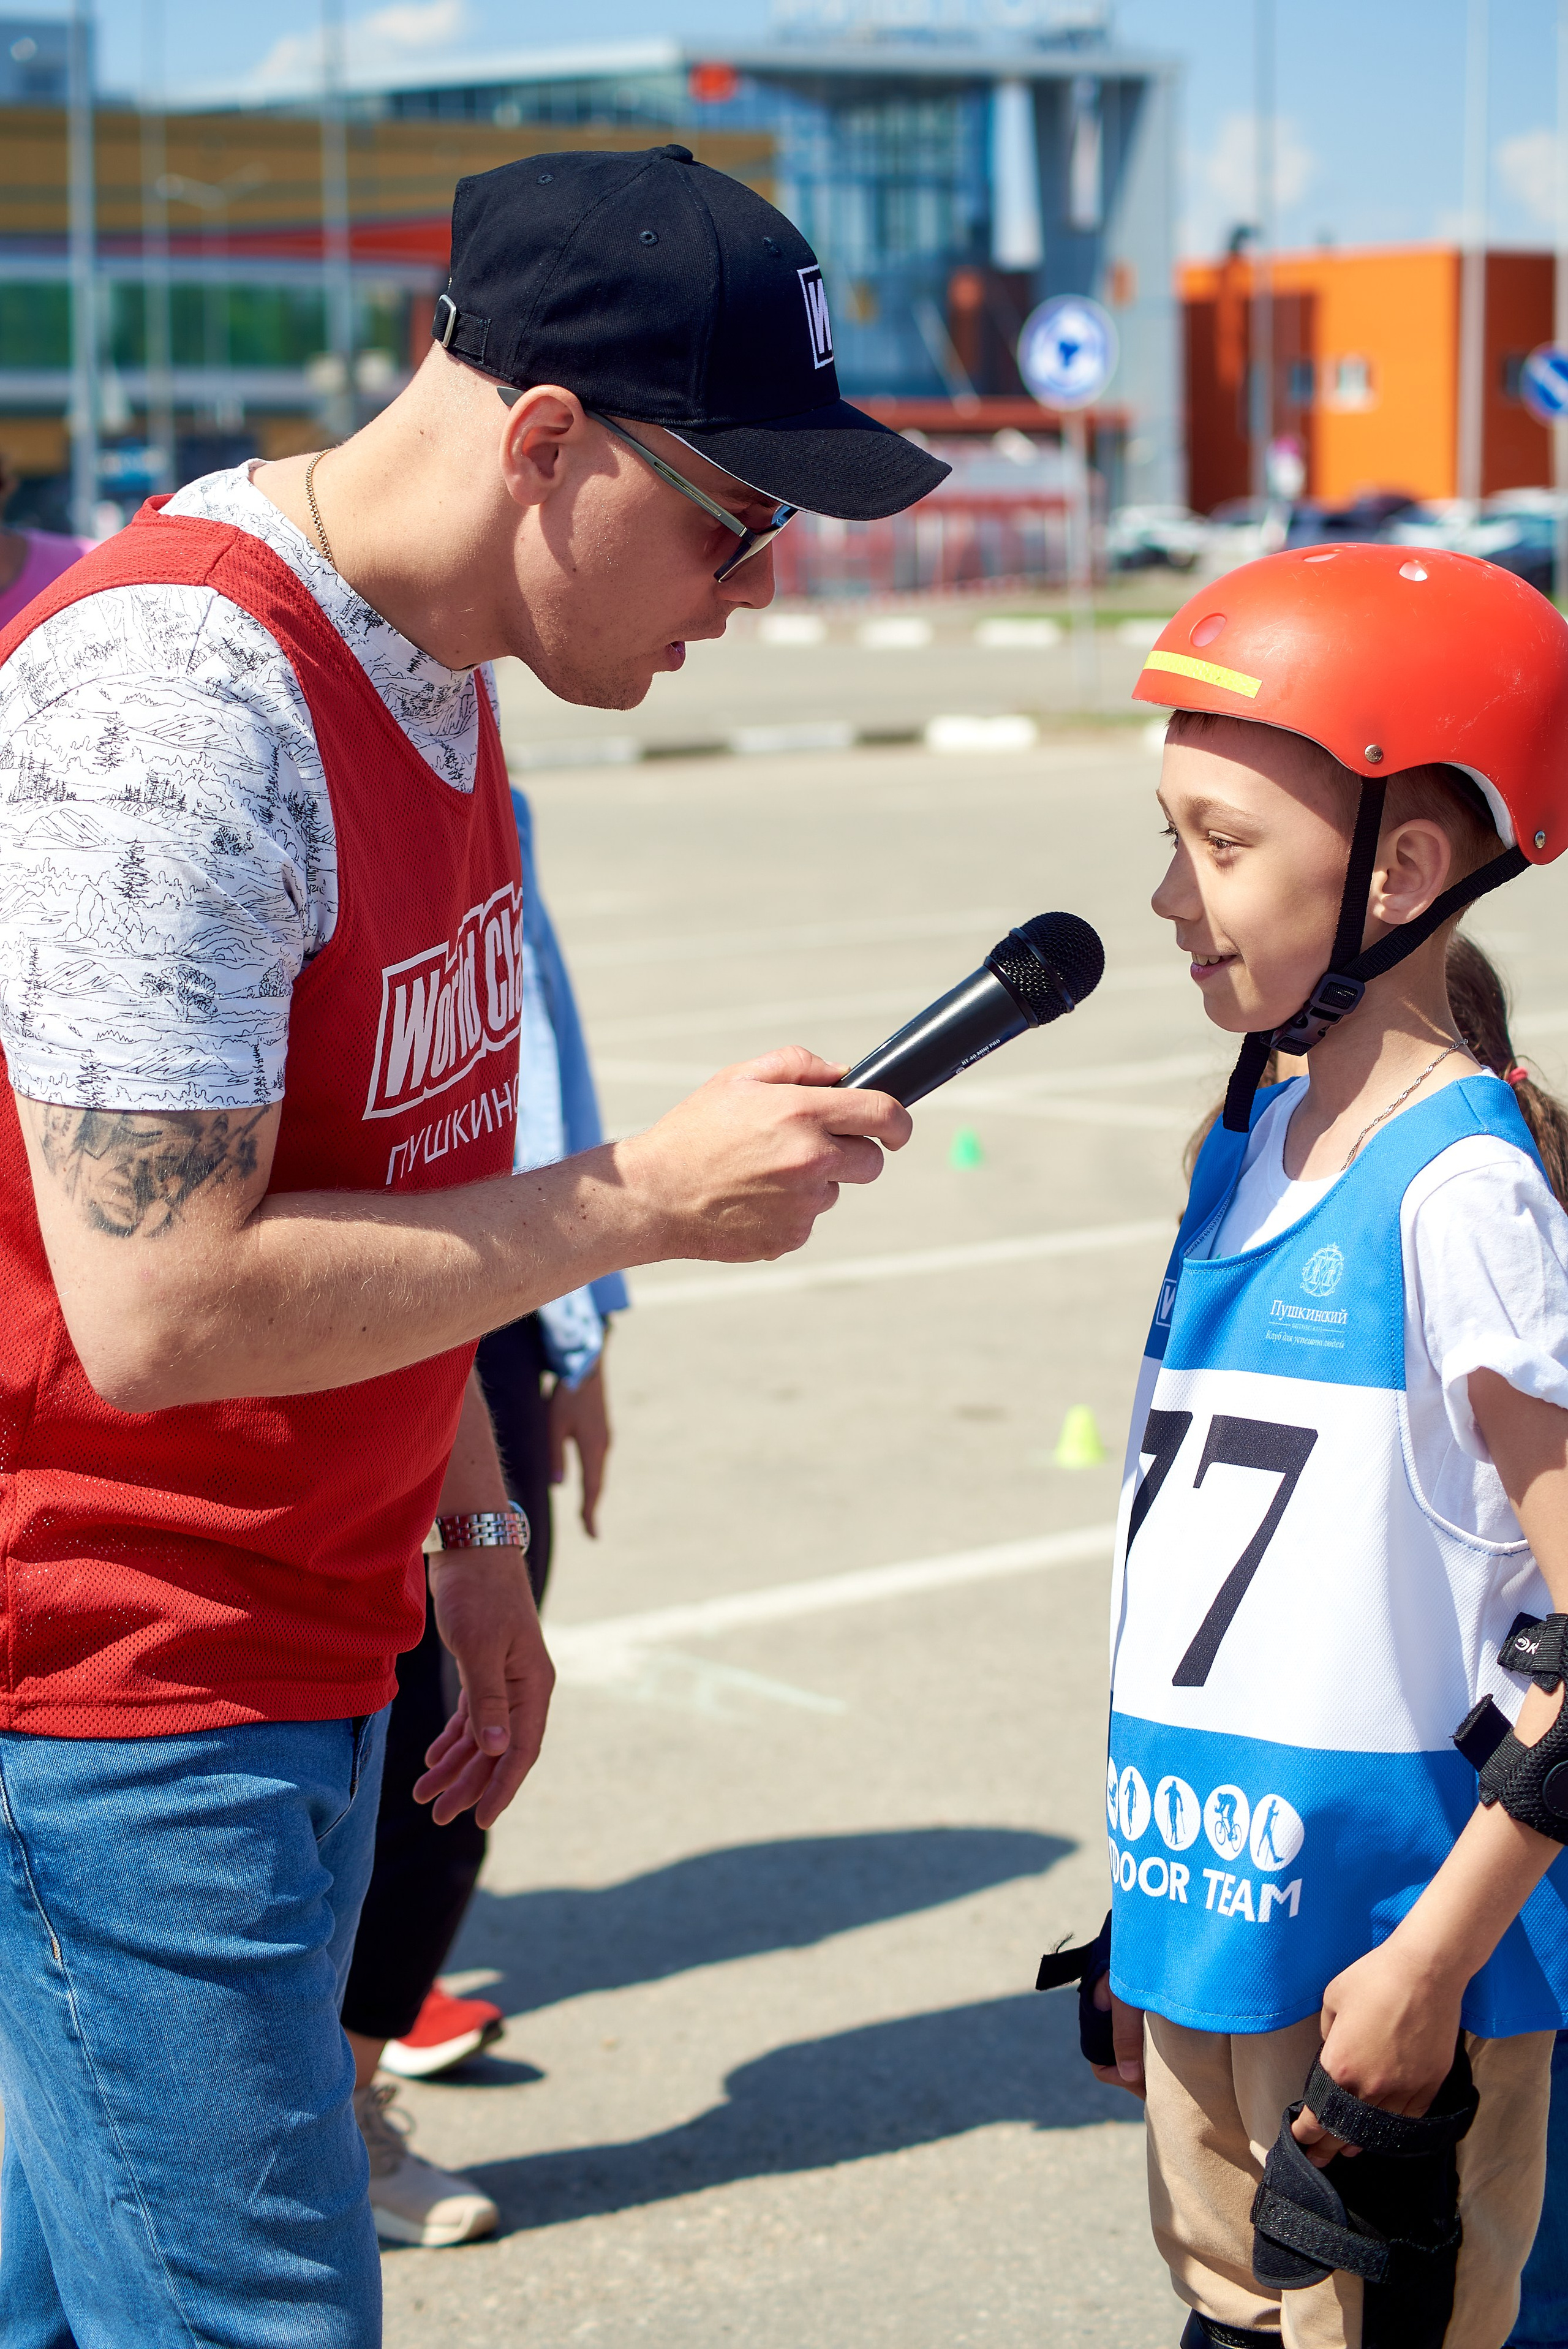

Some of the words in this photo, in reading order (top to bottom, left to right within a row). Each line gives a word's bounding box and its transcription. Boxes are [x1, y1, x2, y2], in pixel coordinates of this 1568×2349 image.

[385, 929, 482, 1098] World
[976, 1046, 989, 1056] MINI
[989, 1039, 1001, 1048] PRO
[1270, 1300, 1348, 1324] Пушкинский
[1265, 1330, 1282, 1343] Клуб
[1125, 1408, 1318, 1687] 77
[1202, 1868, 1302, 1923] TEAM
